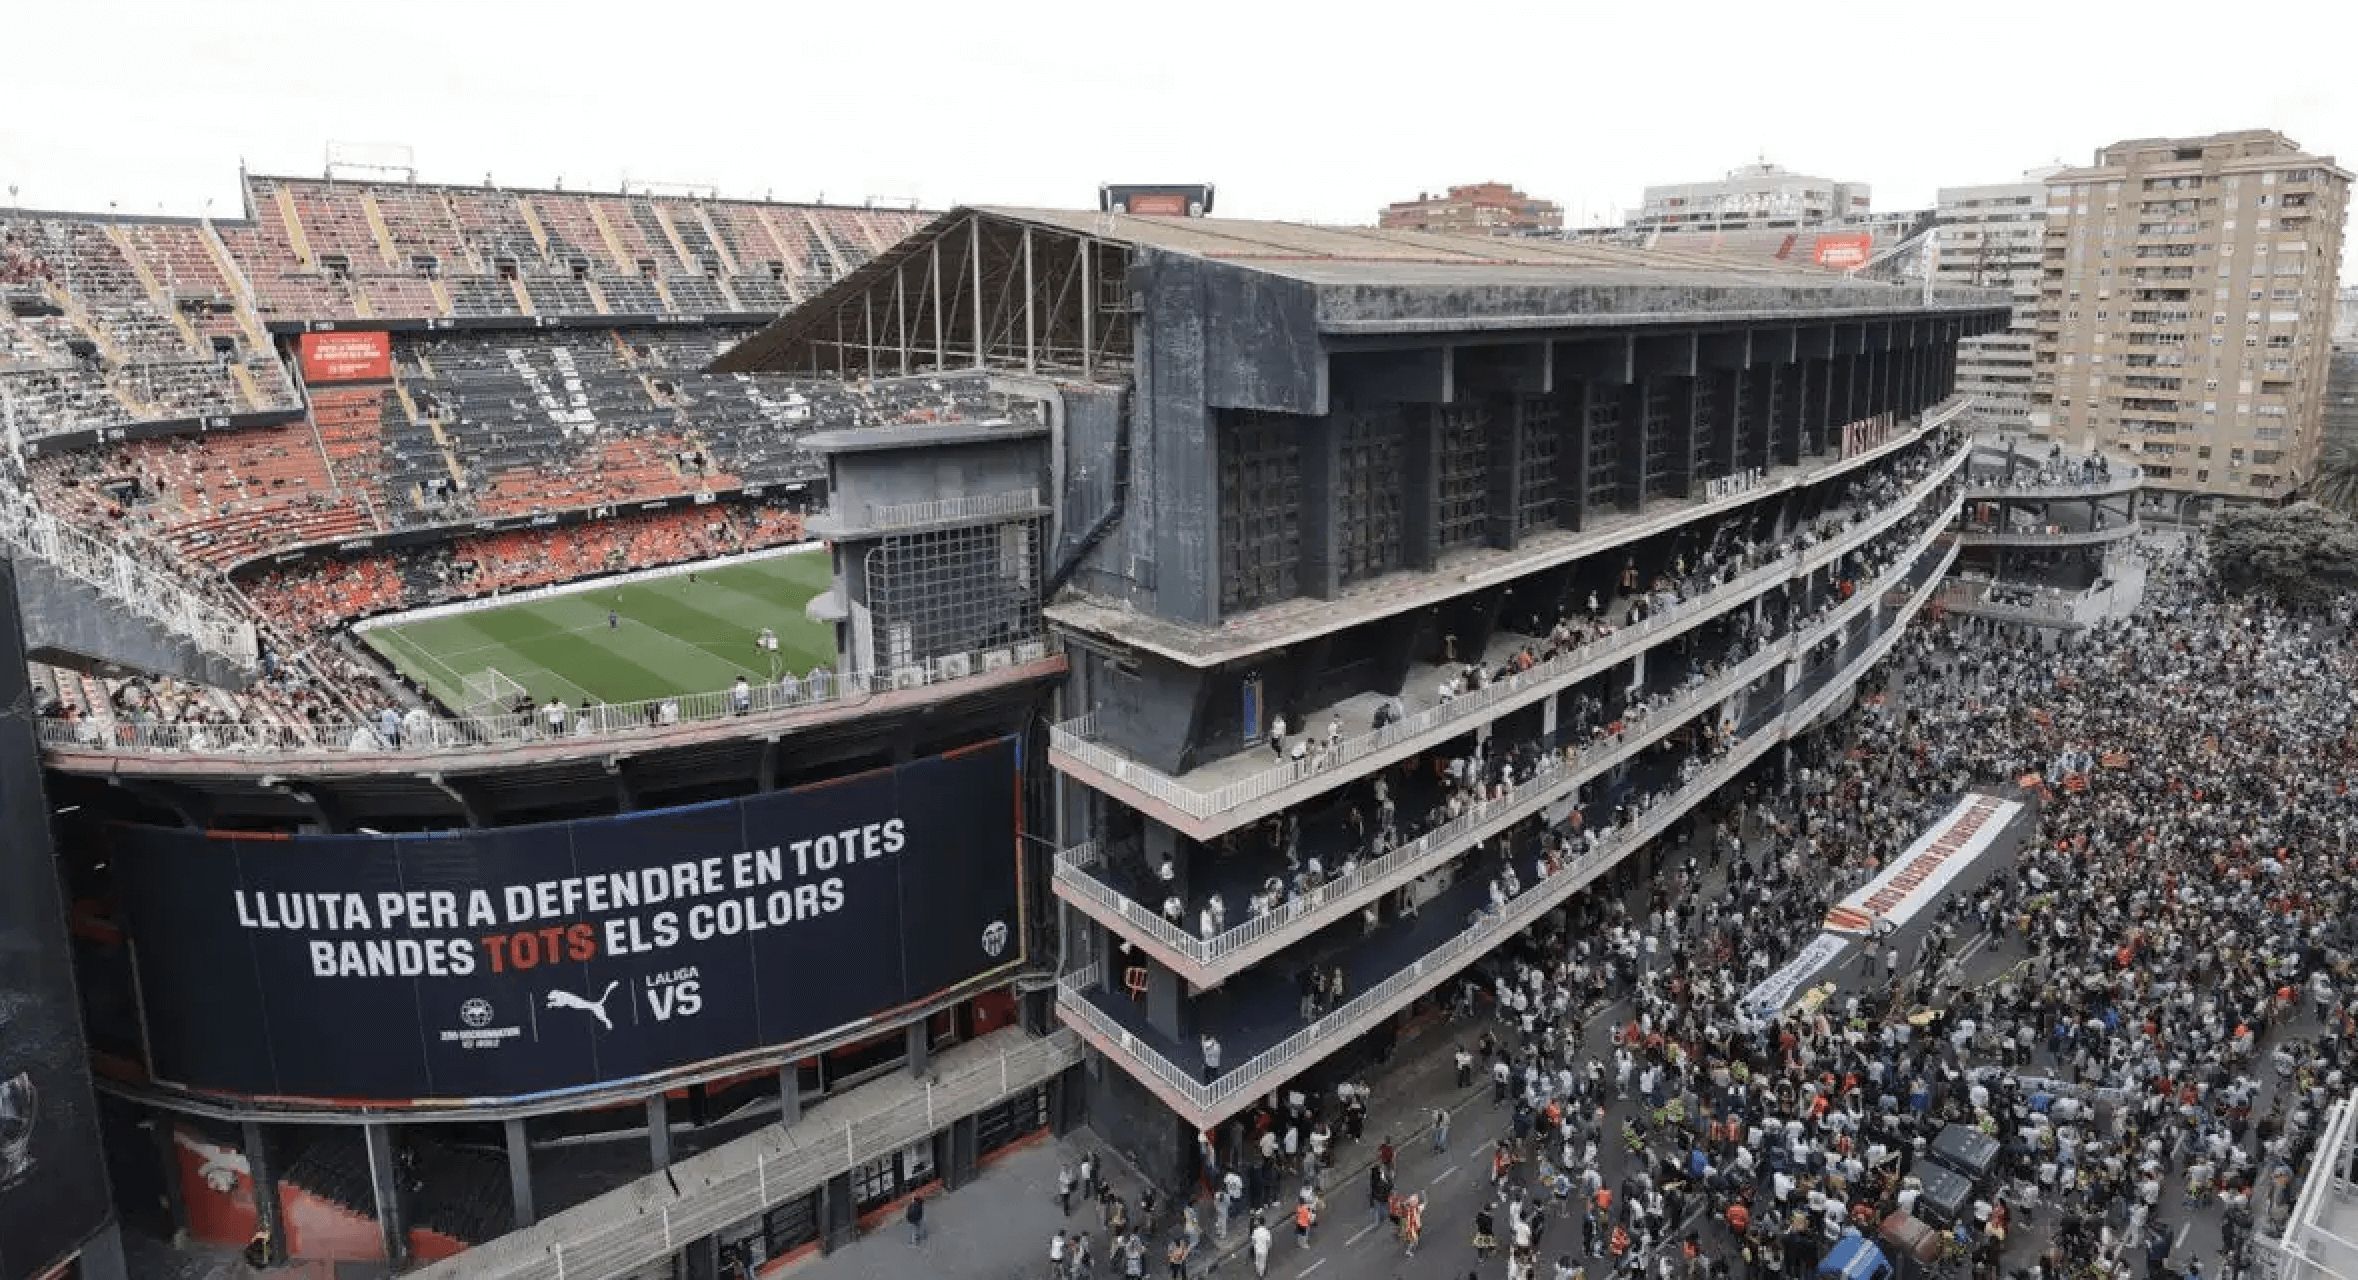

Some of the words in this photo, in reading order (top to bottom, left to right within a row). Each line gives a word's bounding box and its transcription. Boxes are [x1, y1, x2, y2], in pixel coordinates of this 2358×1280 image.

[236, 890, 372, 929] LLUITA
[379, 892, 459, 929] PER
[468, 890, 497, 927] A
[504, 857, 724, 923] DEFENDRE
[732, 845, 783, 889] EN
[791, 819, 905, 875] TOTES
[311, 940, 476, 976] BANDES
[484, 924, 597, 973] TOTS
[605, 912, 679, 955] ELS
[688, 878, 844, 940] COLORS
[646, 966, 699, 986] LALIGA
[647, 982, 701, 1021] VS
